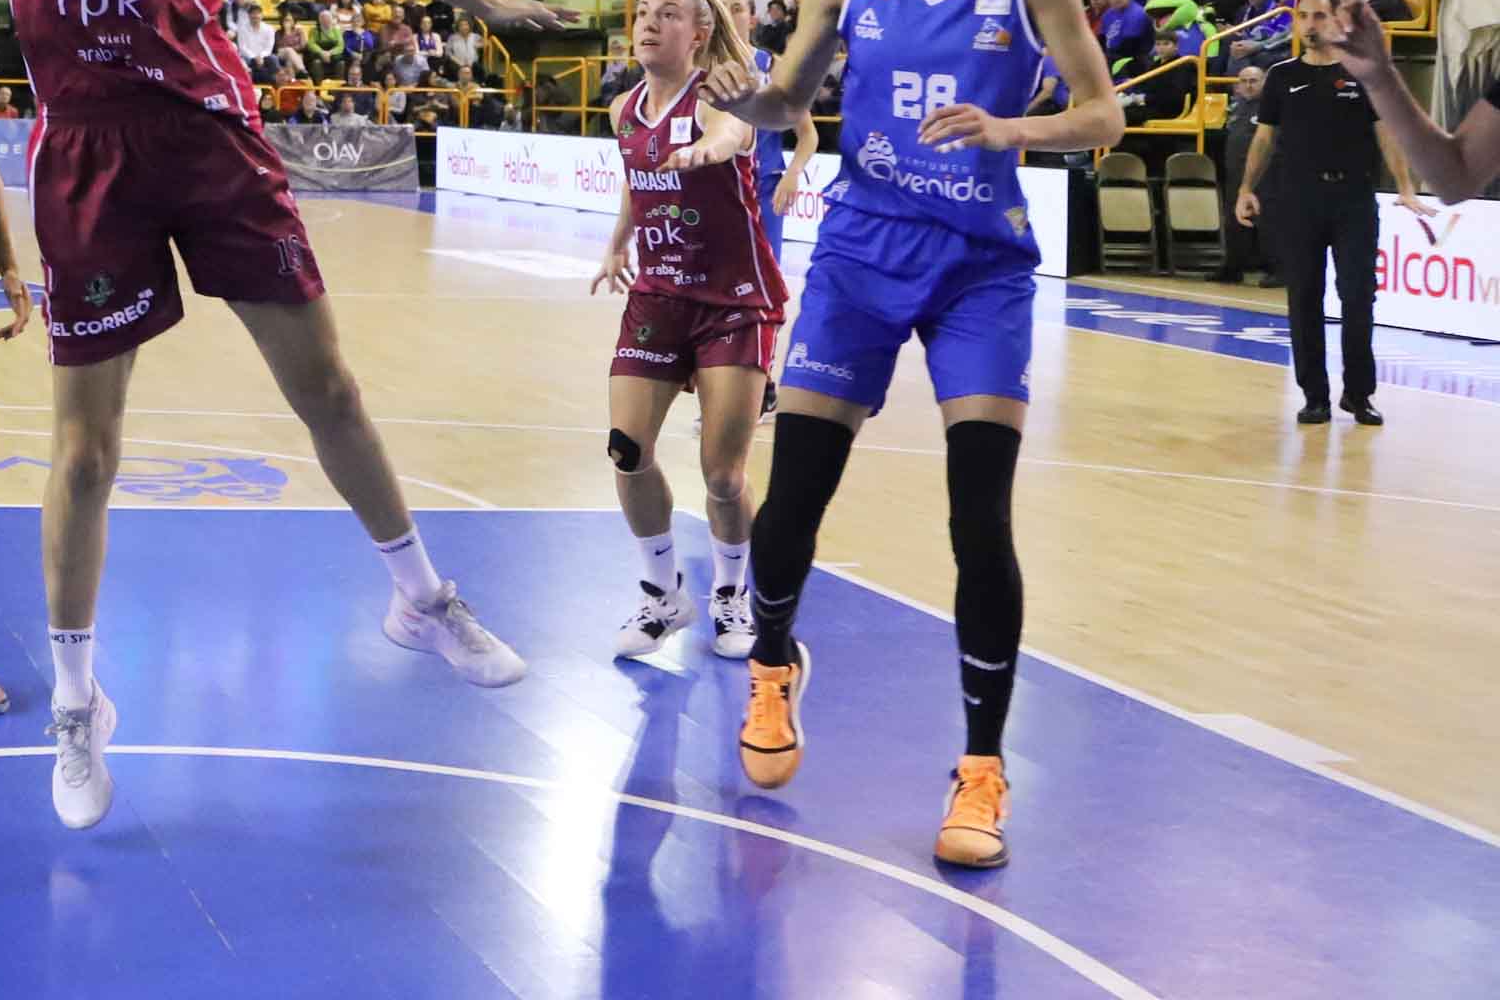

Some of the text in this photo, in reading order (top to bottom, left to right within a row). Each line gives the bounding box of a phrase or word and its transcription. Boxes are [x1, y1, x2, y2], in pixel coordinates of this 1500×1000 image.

[892, 70, 957, 120] 28
[646, 134, 659, 162] 4
[629, 168, 682, 191] ARASKI
[634, 219, 685, 251] rpk
[1373, 234, 1475, 303] alcon
[52, 299, 151, 337] EL CORREO
